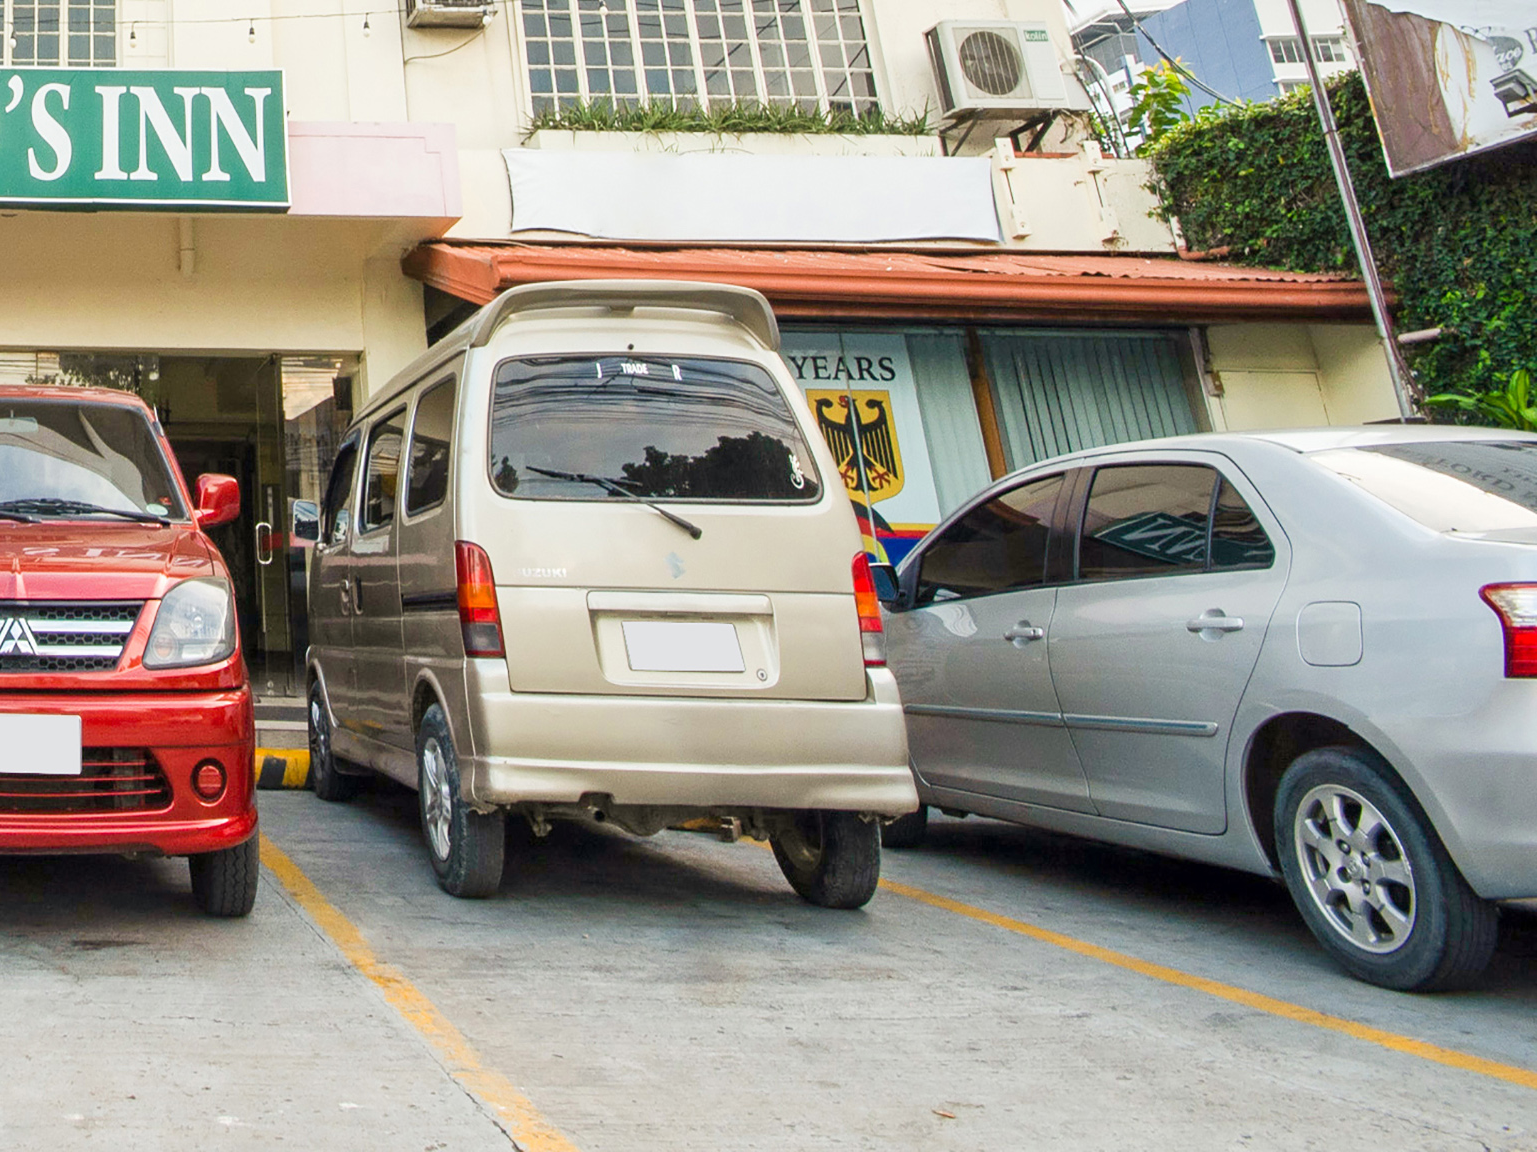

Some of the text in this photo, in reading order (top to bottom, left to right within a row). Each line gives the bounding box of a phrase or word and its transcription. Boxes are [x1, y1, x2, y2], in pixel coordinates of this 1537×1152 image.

[94, 85, 272, 182] INN
[620, 363, 649, 375] TRADE
[671, 364, 683, 381] R
[788, 356, 896, 381] YEARS
